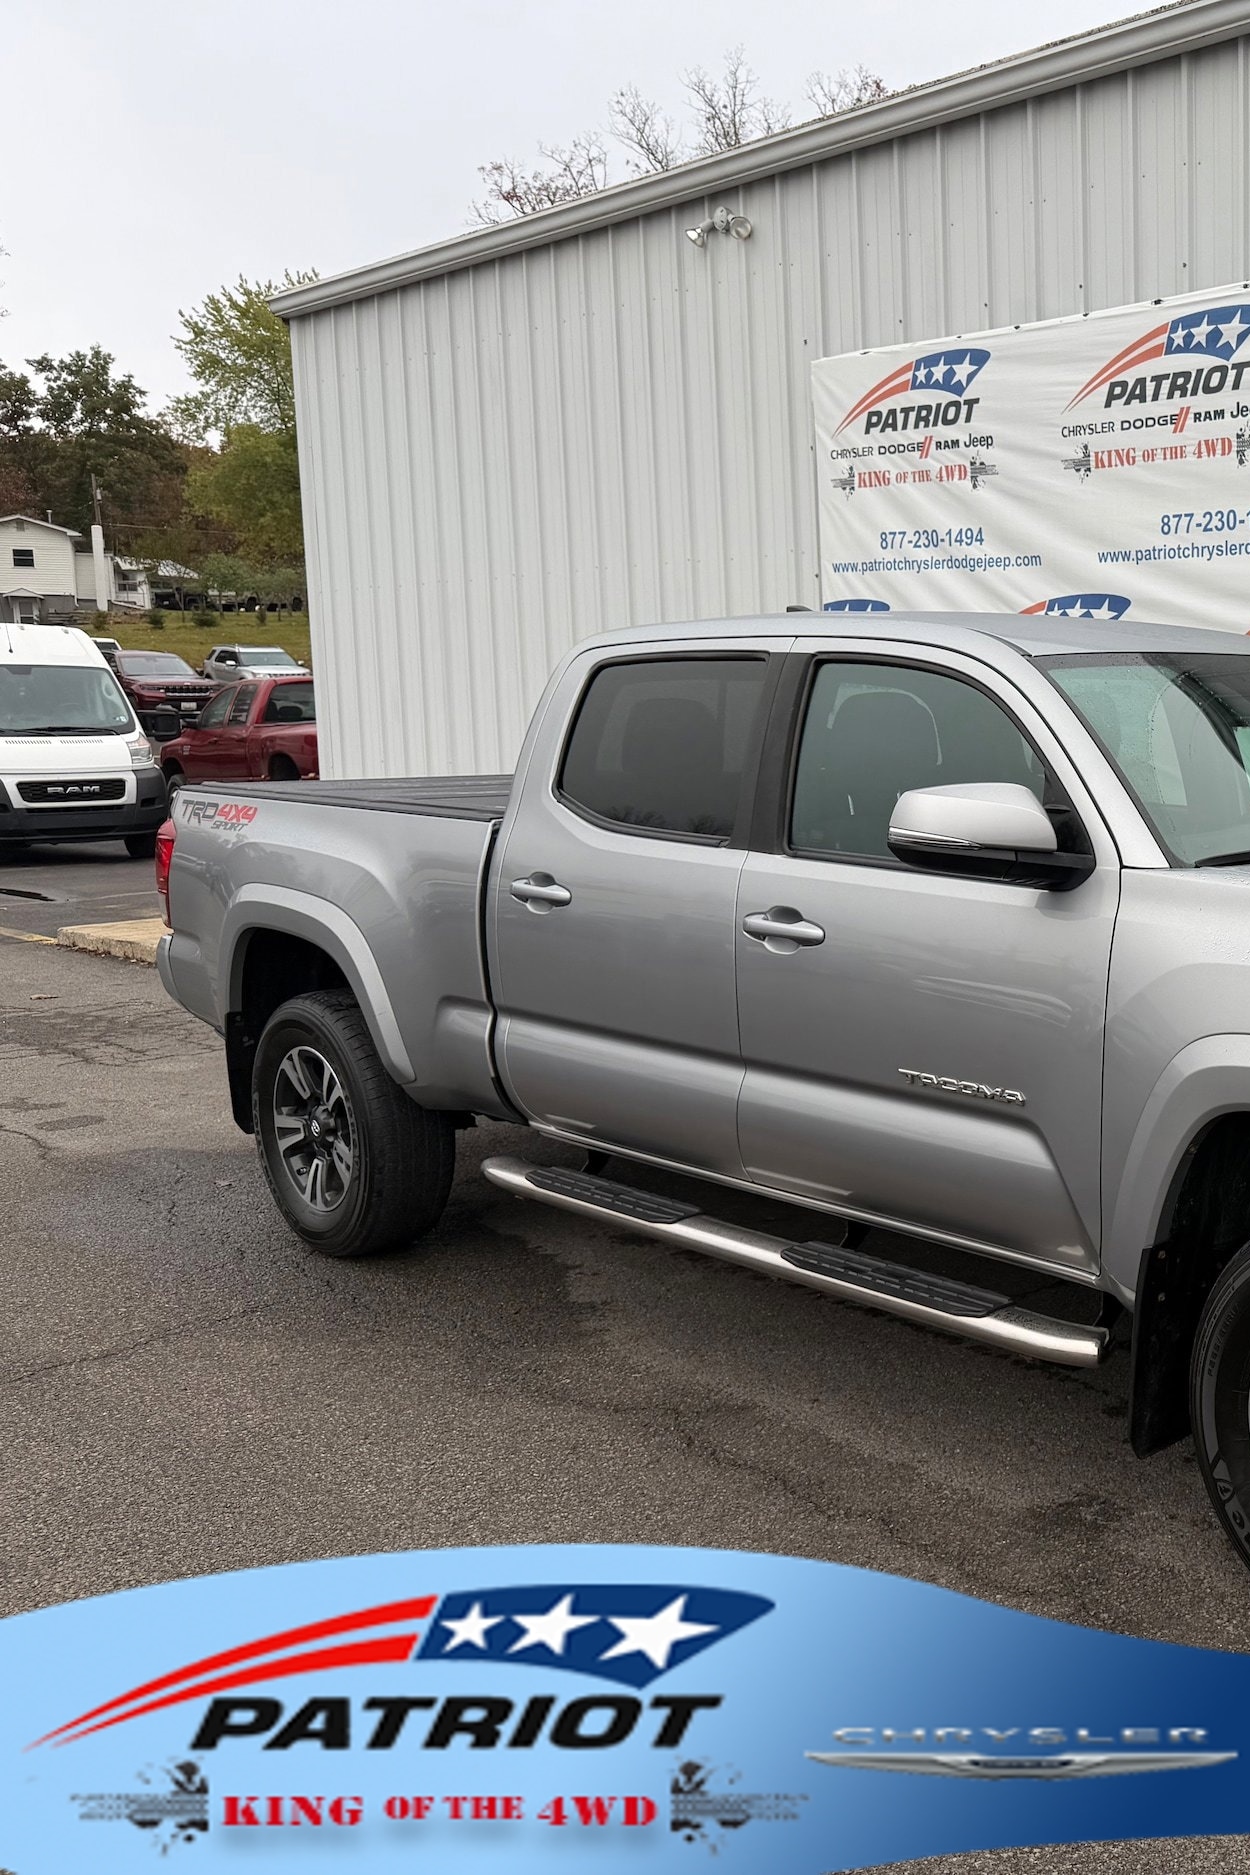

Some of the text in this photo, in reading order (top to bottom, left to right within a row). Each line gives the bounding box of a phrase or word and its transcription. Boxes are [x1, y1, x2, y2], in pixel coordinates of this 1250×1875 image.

[864, 398, 980, 434] PATRIOT
[1061, 421, 1115, 438] CHRYSLER
[1121, 414, 1177, 431] DODGE
[1193, 409, 1225, 423] RAM
[831, 434, 994, 460] CHRYSLER DODGE RAM Jeep
[1094, 437, 1233, 469] KING OF THE 4WD
[858, 464, 967, 488] KING OF THE 4WD
[880, 527, 984, 550] 877-230-1494
[832, 553, 1042, 575] www.patriotchryslerdodgejeep.com
[47, 785, 99, 794] RAM
[211, 820, 248, 832] SPORT
[898, 1068, 1026, 1106] TACOMA
